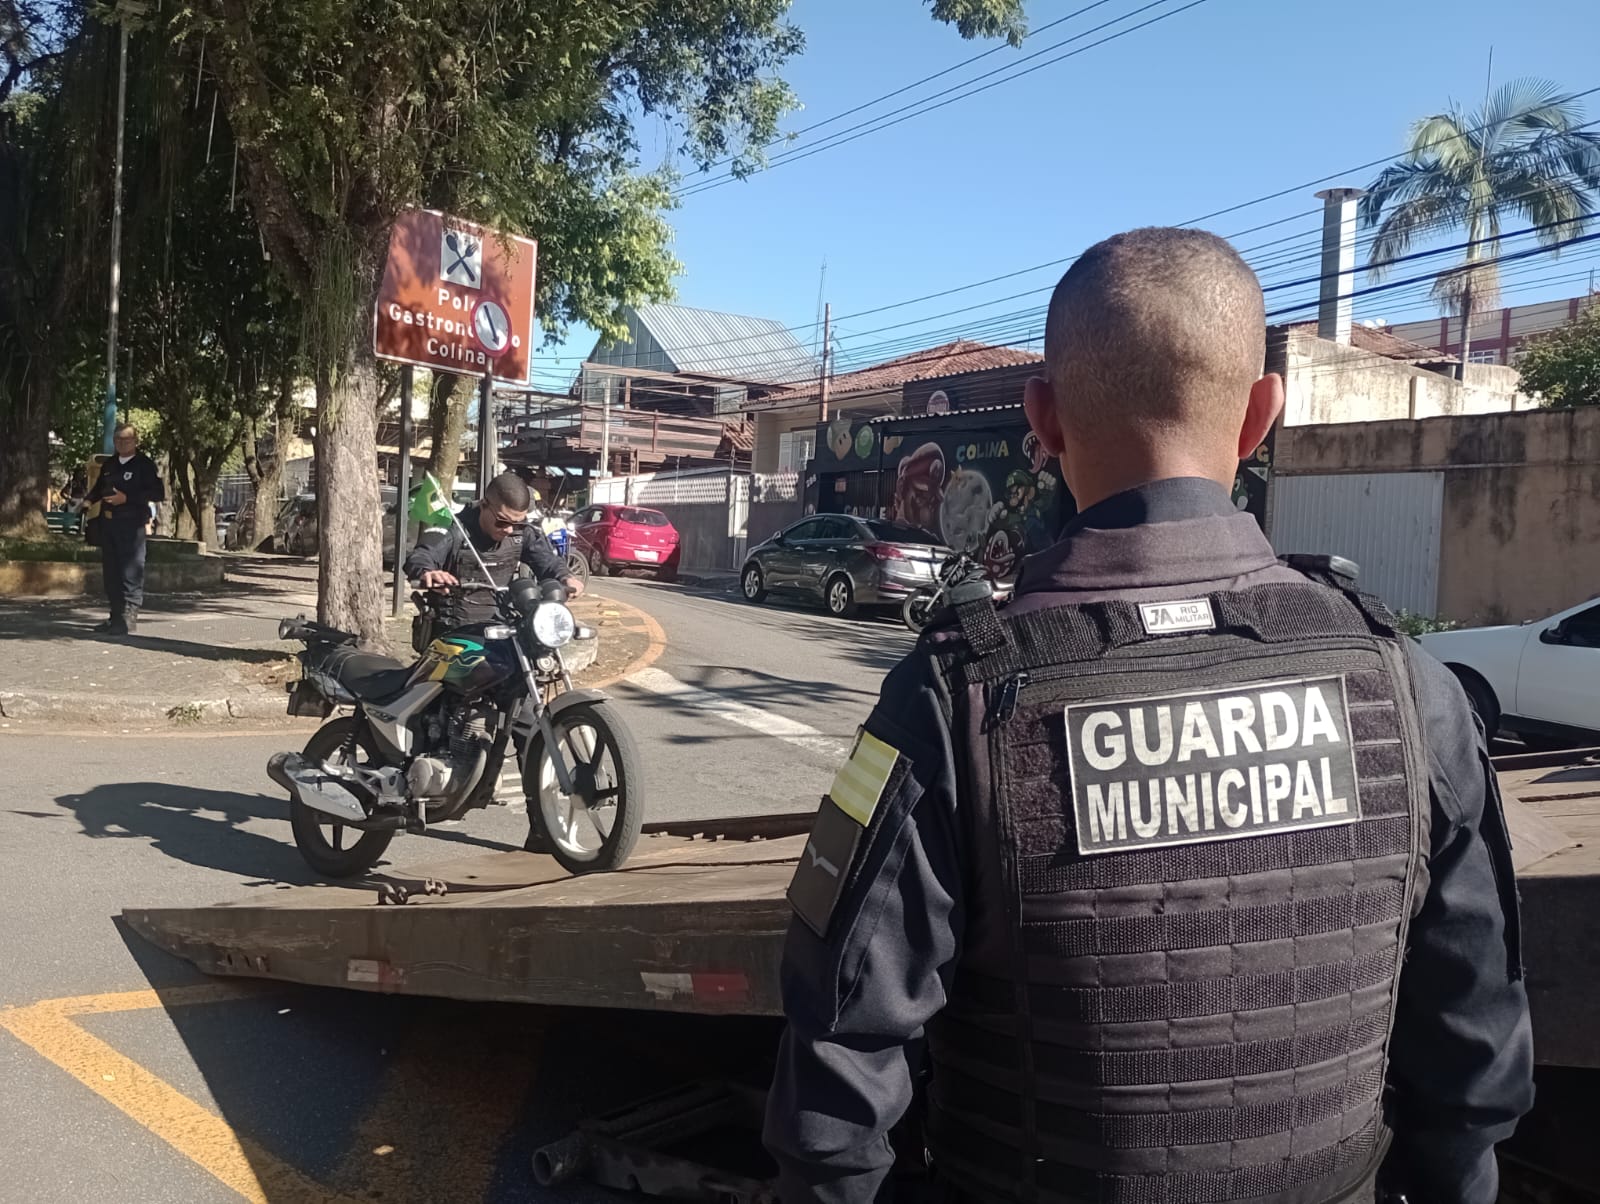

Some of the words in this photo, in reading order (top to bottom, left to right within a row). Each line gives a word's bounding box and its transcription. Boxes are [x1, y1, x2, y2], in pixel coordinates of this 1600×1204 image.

[438, 288, 476, 312] Pol
[389, 303, 521, 348] Gastrono
[427, 338, 485, 365] Colina
[956, 440, 1009, 462] COLINA
[1175, 614, 1209, 623] MILITAR
[1081, 687, 1341, 771] GUARDA
[1087, 757, 1348, 842] MUNICIPAL
